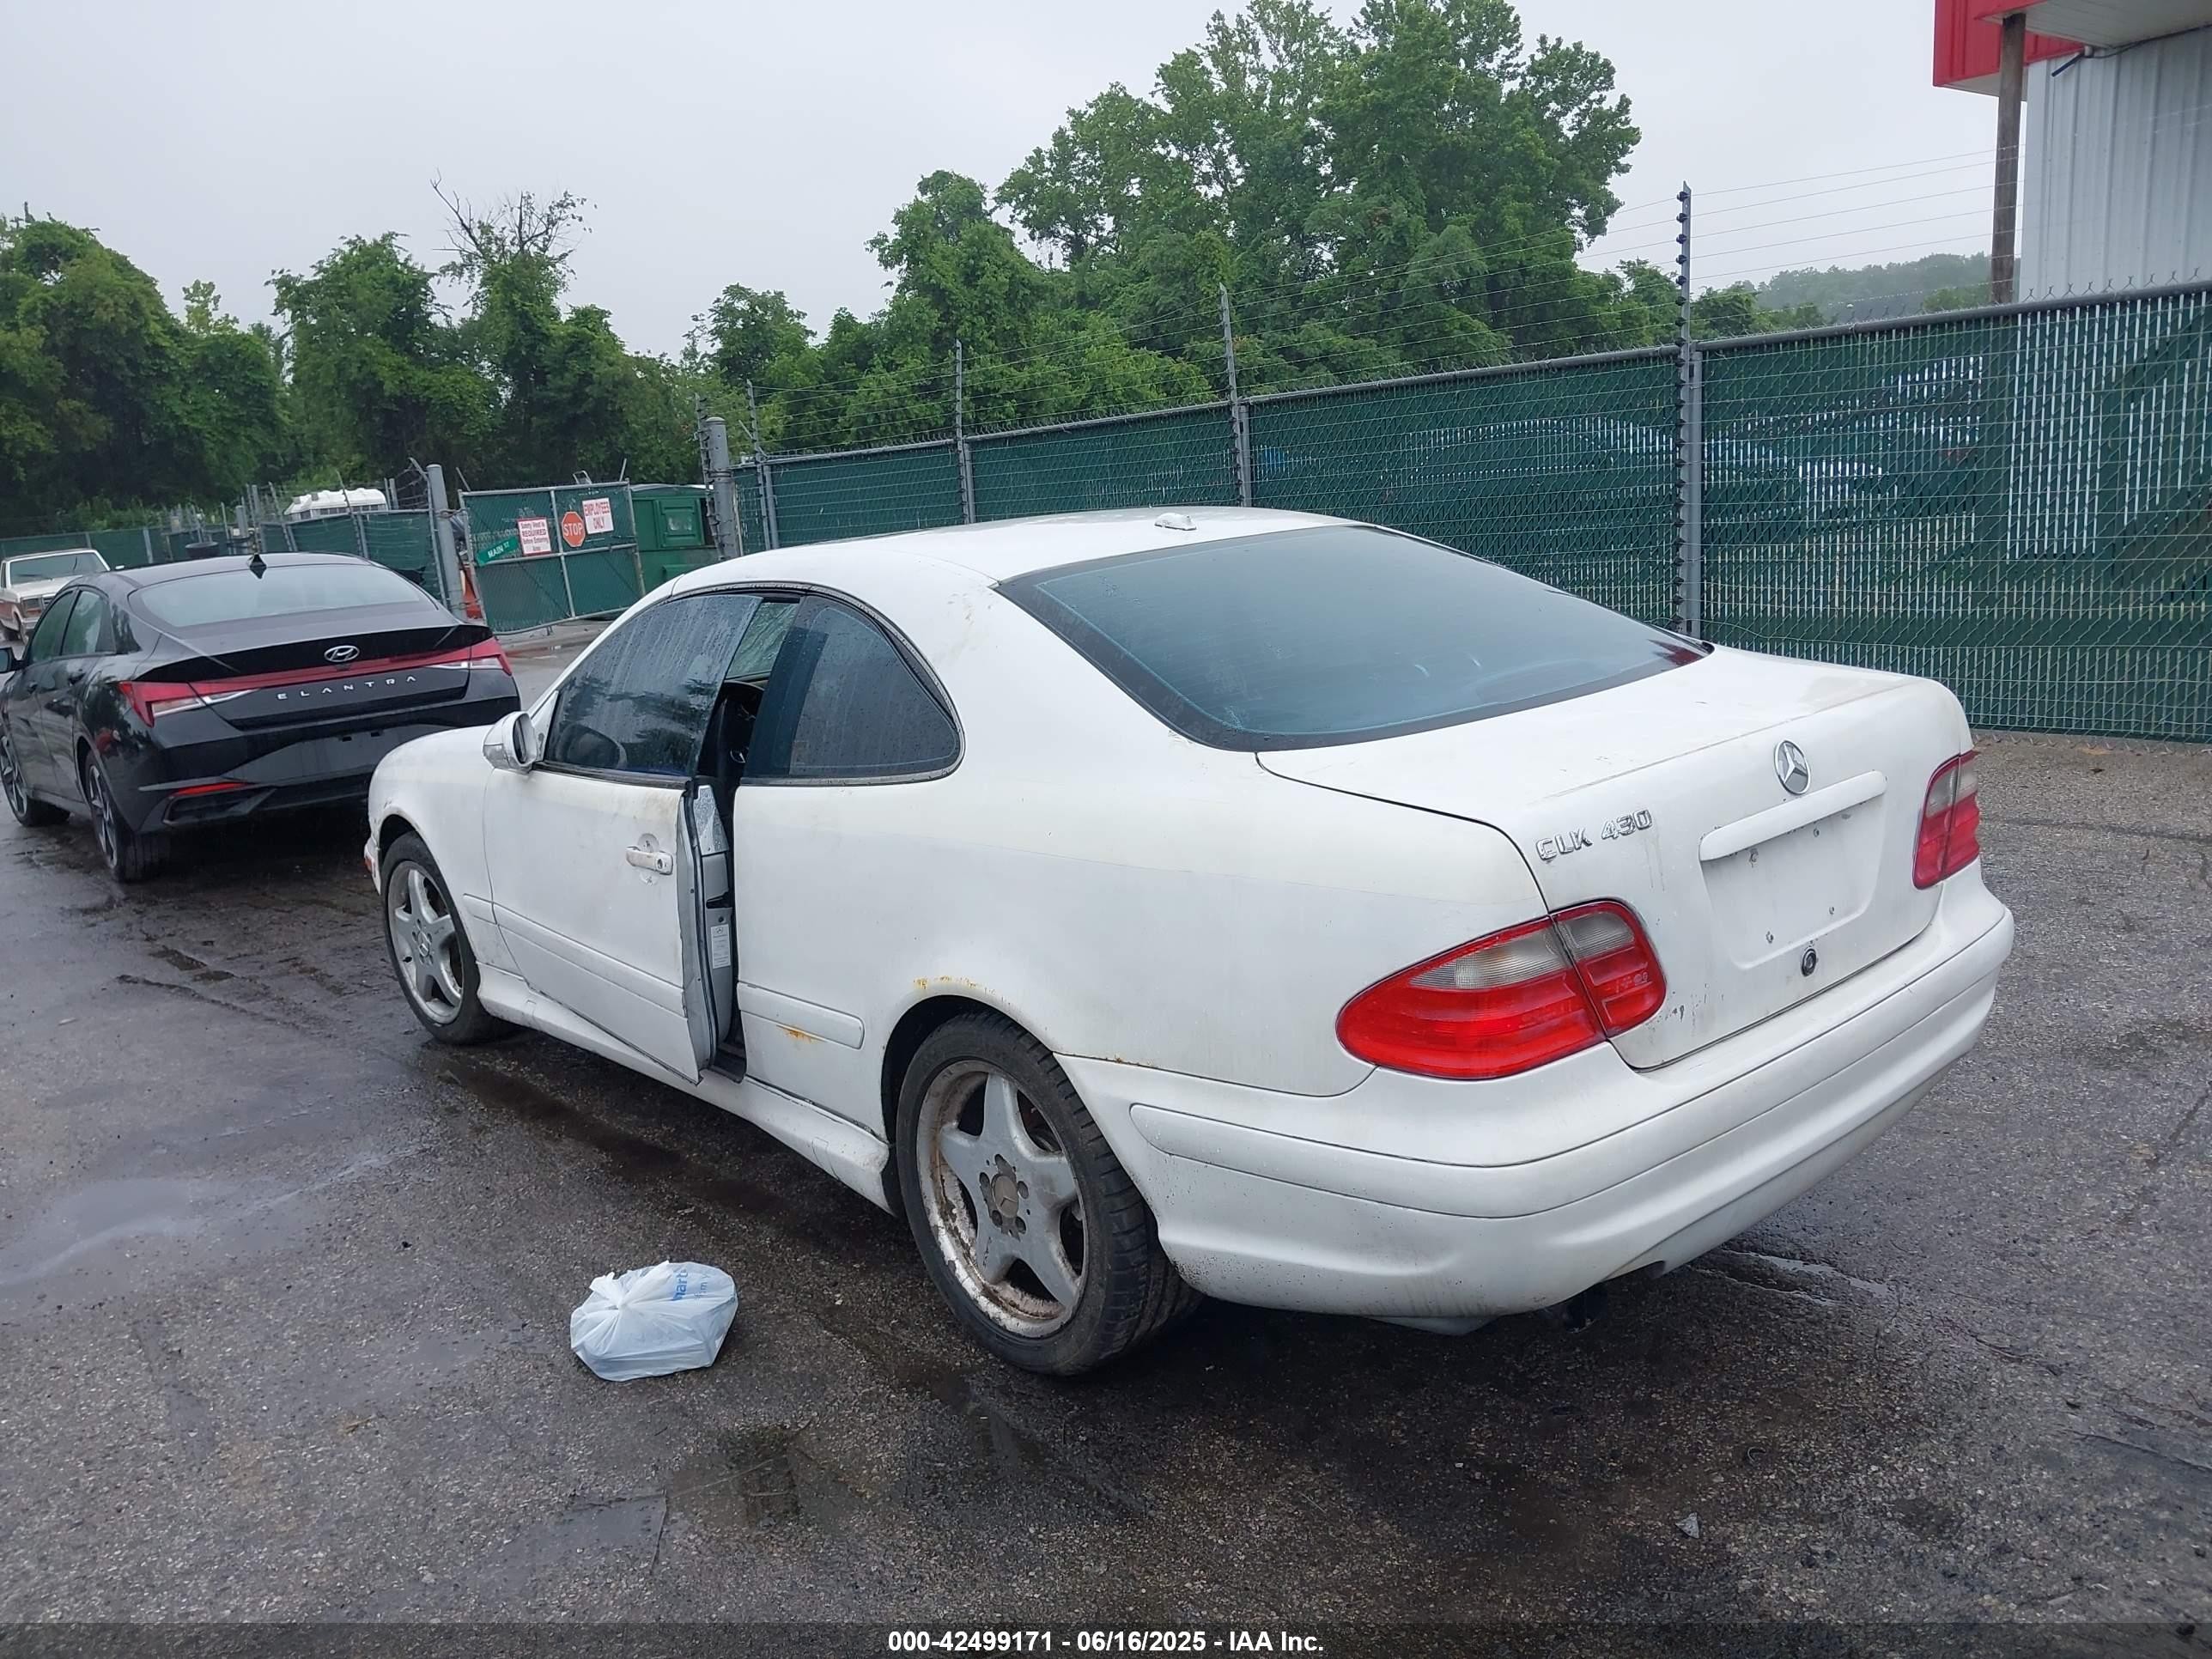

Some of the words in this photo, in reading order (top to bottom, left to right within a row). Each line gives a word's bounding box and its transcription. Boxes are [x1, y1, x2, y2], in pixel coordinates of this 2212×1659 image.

[584, 501, 610, 516] EMPLOYEES
[563, 522, 583, 537] STOP
[593, 517, 605, 529] ONLY
[488, 545, 504, 558] MAIN
[277, 676, 416, 700] ELANTRA
[1535, 827, 1593, 861] CLK
[1601, 810, 1653, 840] 430
